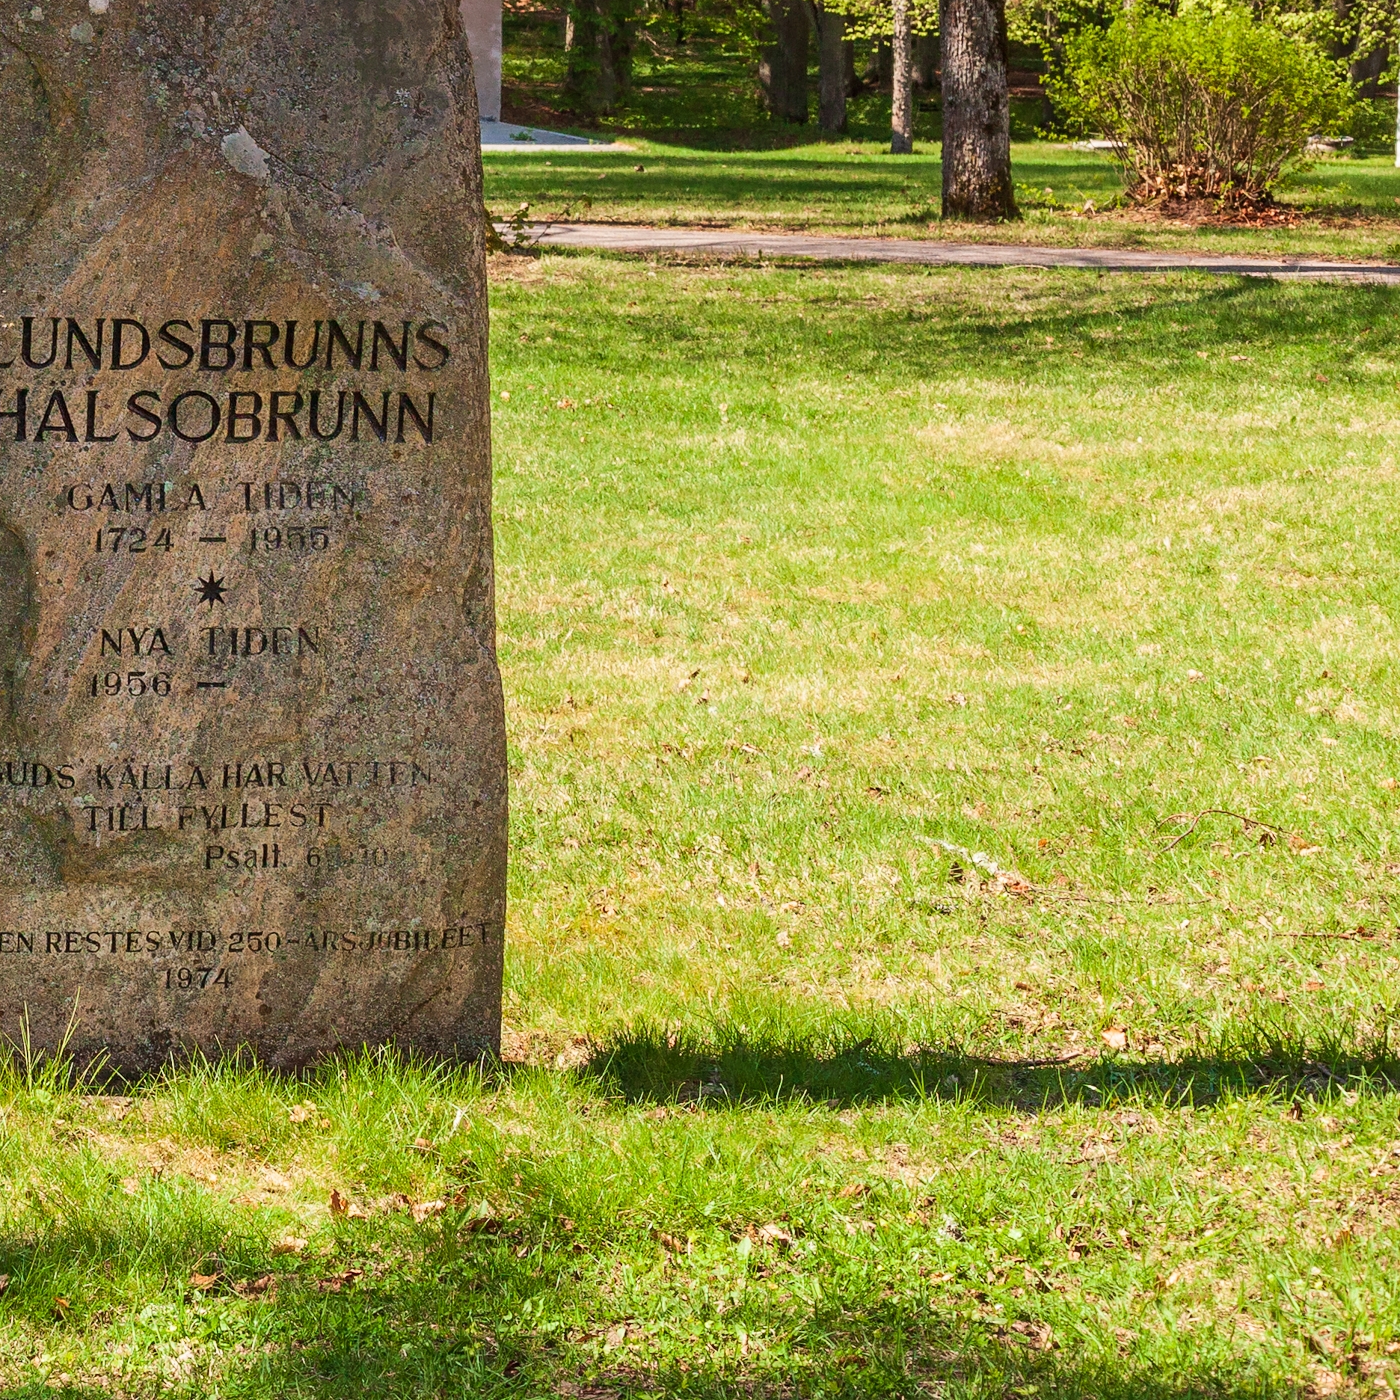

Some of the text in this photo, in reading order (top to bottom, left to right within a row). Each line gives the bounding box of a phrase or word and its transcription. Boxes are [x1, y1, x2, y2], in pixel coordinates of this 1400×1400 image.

[66, 480, 356, 513] GAMLA TIDEN
[95, 526, 175, 554] 1724
[250, 525, 330, 554] 1955
[100, 626, 320, 657] NYA TIDEN
[91, 670, 172, 698] 1956
[221, 761, 287, 789] HAR
[303, 760, 432, 787] VATTEN
[81, 803, 333, 832] TILL FYLLEST
[205, 843, 288, 870] Psalt.
[45, 930, 160, 954] RESTES
[166, 930, 217, 953] VID
[164, 967, 233, 990] 1974
